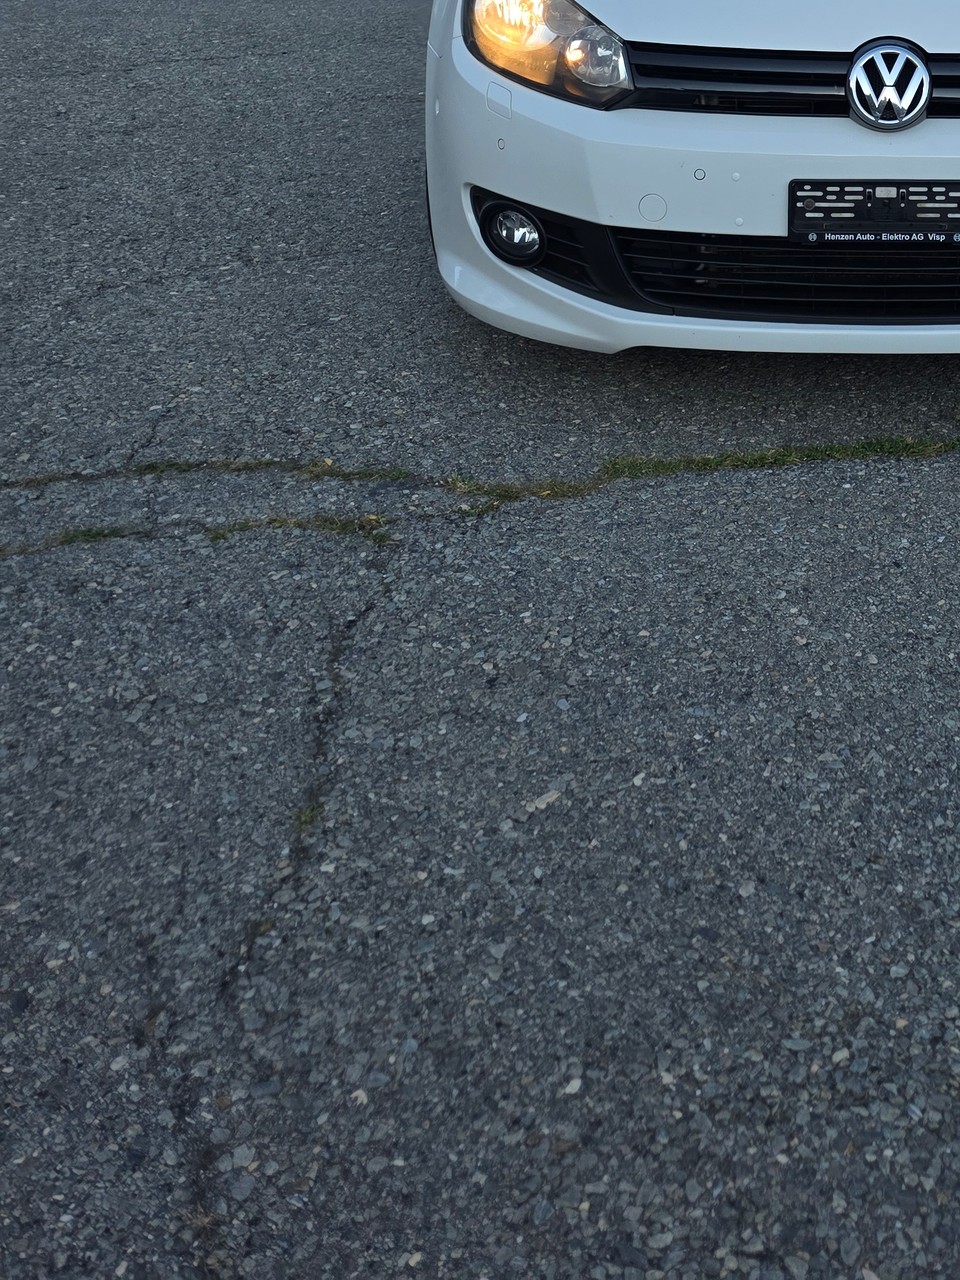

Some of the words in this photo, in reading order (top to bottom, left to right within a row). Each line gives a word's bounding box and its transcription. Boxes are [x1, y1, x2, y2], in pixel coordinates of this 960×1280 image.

[825, 233, 854, 241] Henzen
[855, 233, 875, 241] Auto
[882, 233, 910, 241] Elektro
[911, 233, 924, 241] AG
[928, 233, 946, 242] Visp
